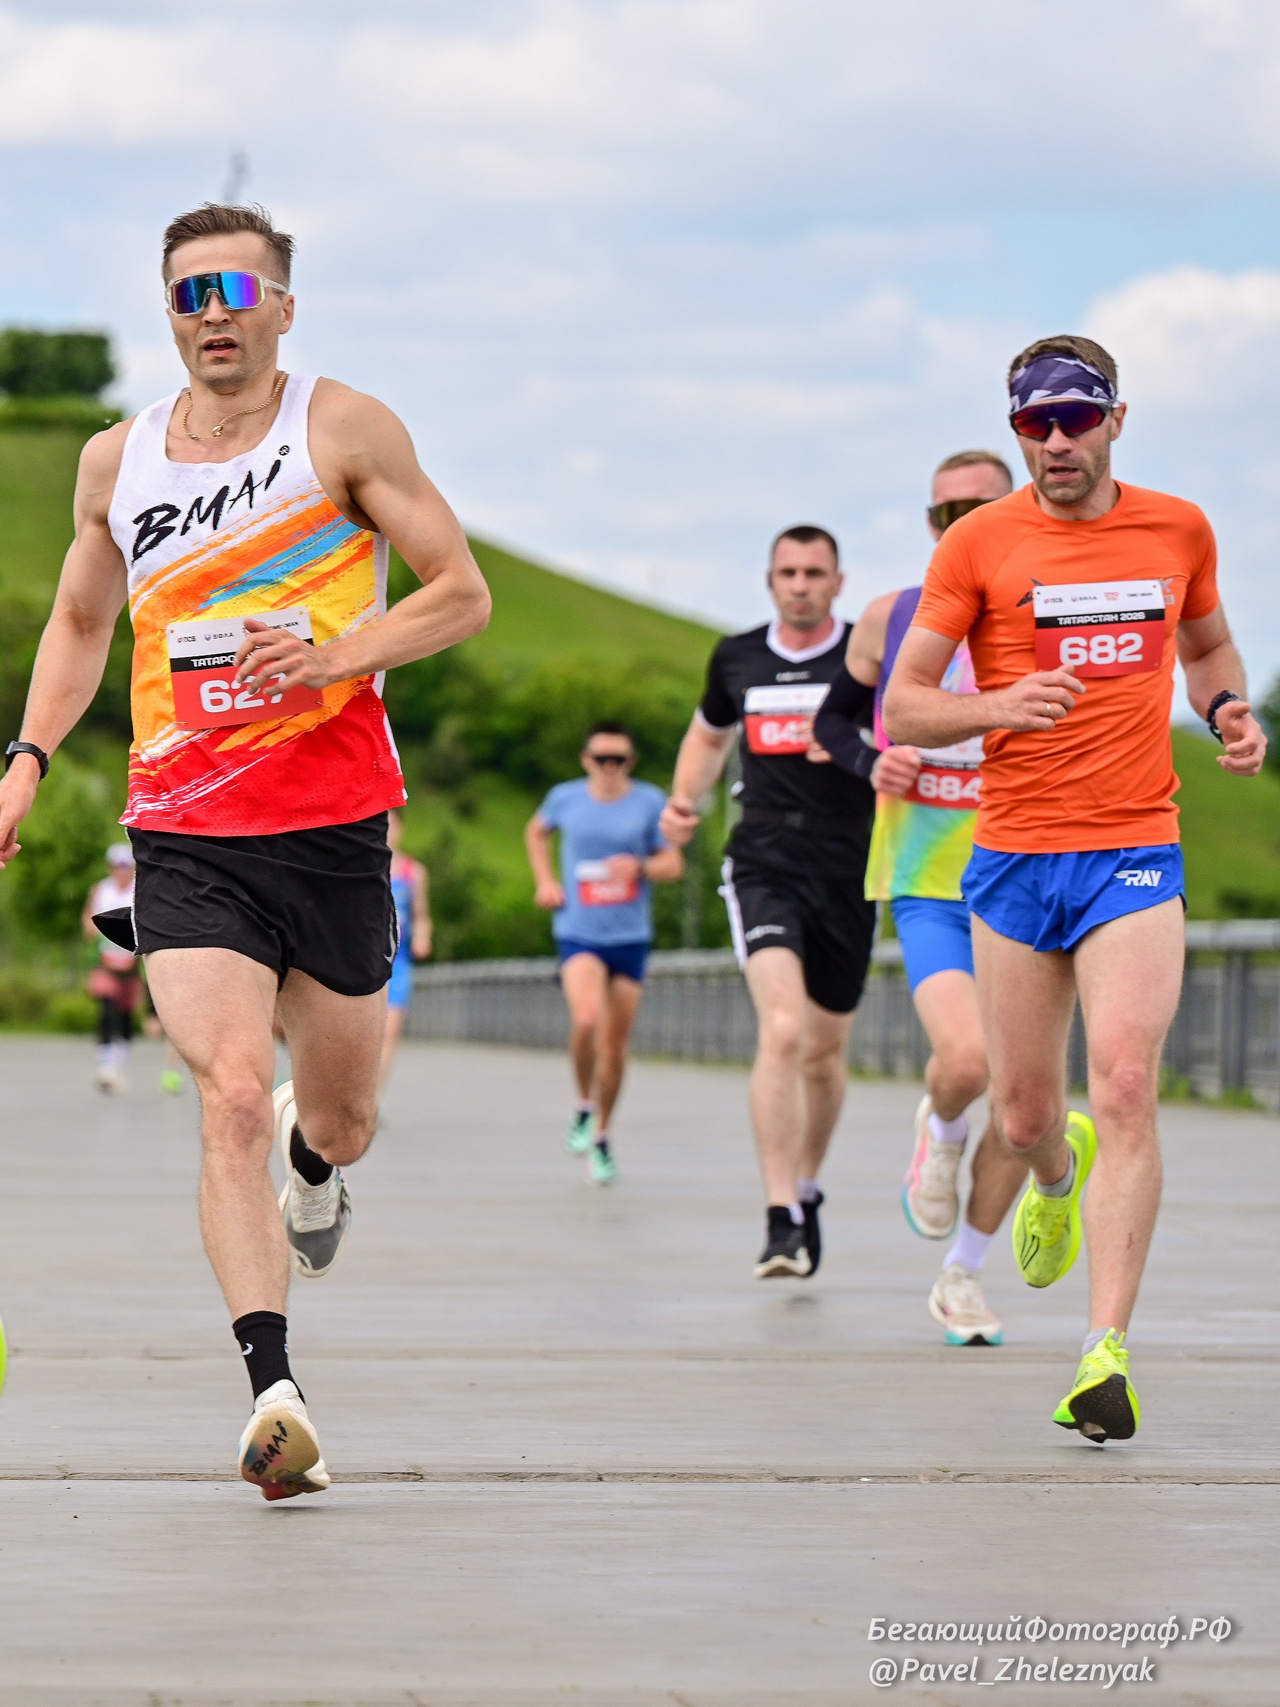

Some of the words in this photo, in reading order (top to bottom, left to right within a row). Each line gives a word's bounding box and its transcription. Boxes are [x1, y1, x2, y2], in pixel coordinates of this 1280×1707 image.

[1057, 613, 1118, 626] ТАТАРСТАН
[1059, 632, 1143, 666] 682
[918, 772, 981, 802] 684
[1114, 869, 1162, 887] RAY
